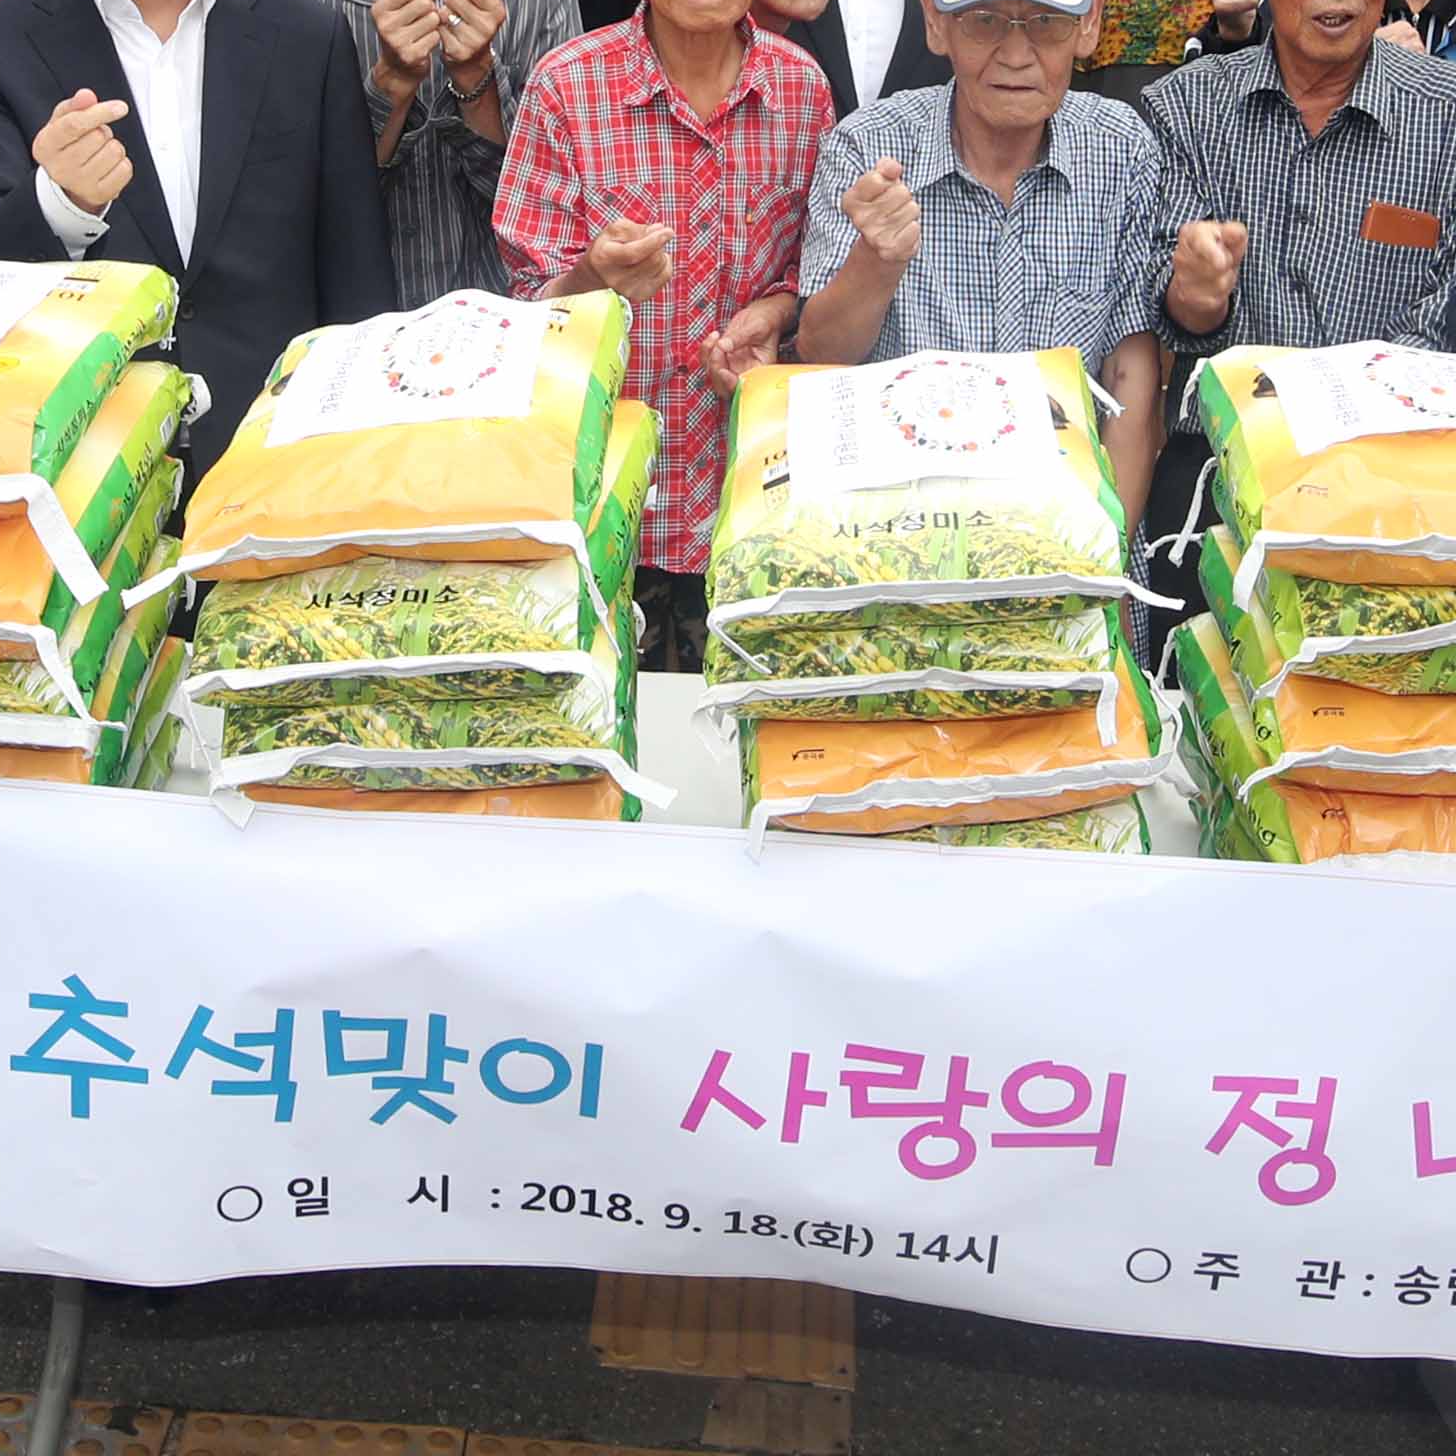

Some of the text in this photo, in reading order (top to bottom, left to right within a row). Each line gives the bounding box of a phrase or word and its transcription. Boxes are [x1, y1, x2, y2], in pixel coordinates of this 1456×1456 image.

[832, 508, 995, 542] 사석정미소
[305, 584, 461, 611] 사석정미소
[9, 972, 604, 1127] 추석맞이
[679, 1042, 1128, 1181] 사랑의
[1203, 1074, 1338, 1206] 정
[895, 1230, 1002, 1275] 14시
